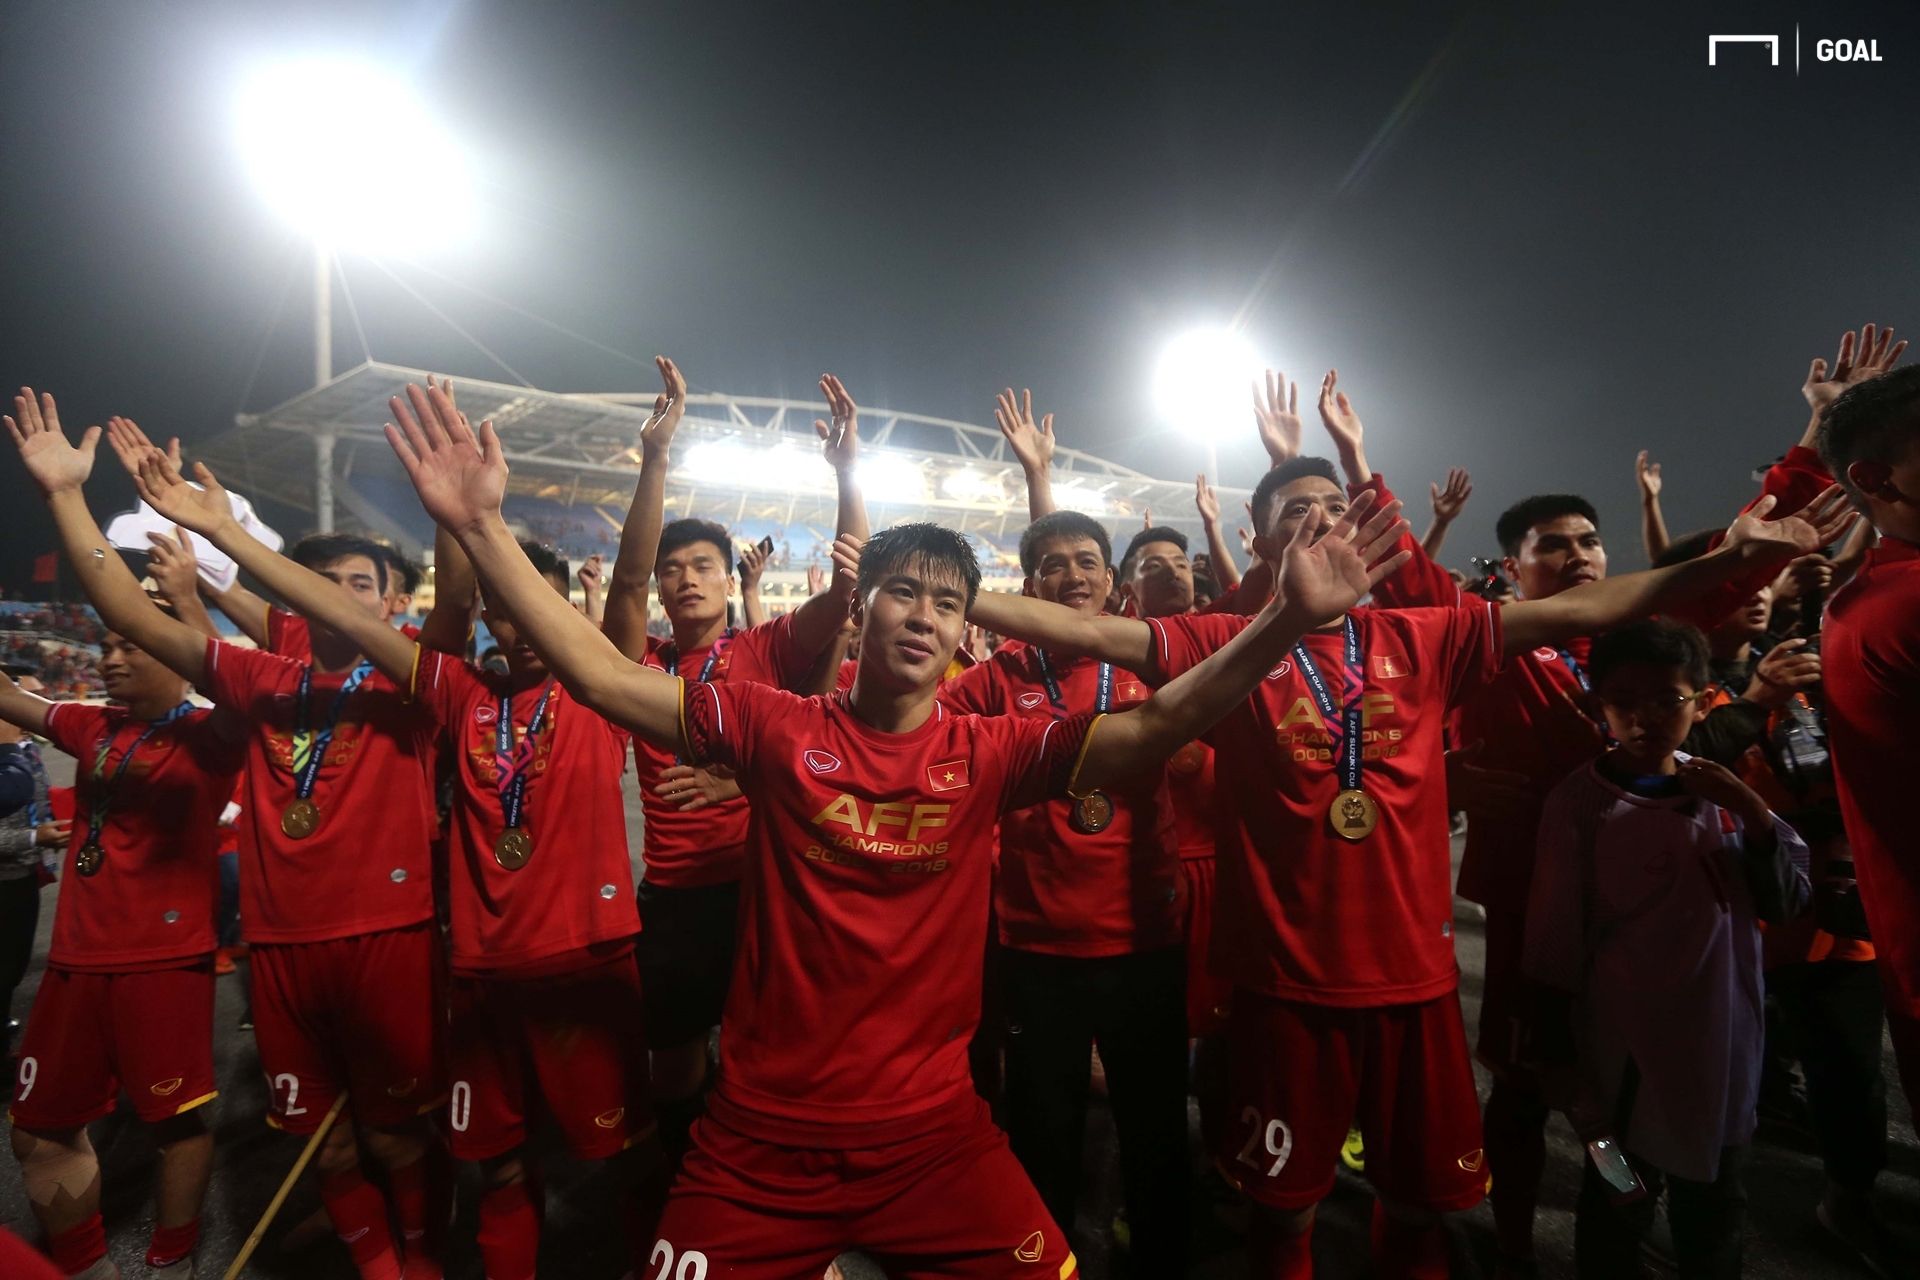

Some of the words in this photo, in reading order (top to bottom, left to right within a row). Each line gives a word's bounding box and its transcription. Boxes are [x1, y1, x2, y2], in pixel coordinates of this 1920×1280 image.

[1296, 647, 1315, 675] SUZUKI
[1312, 675, 1323, 691] CUP
[1320, 692, 1332, 711] 2018
[1276, 694, 1395, 730] AF
[1349, 719, 1357, 736] AFF
[1276, 729, 1402, 746] CHAMONS
[1349, 737, 1357, 770] SUZUKI
[811, 793, 951, 841] AFF
[823, 833, 950, 856] HAMPIONS
[890, 859, 948, 873] 2018
[18, 1056, 39, 1102] 9
[451, 1080, 471, 1132] 0
[1236, 1105, 1293, 1177] 29
